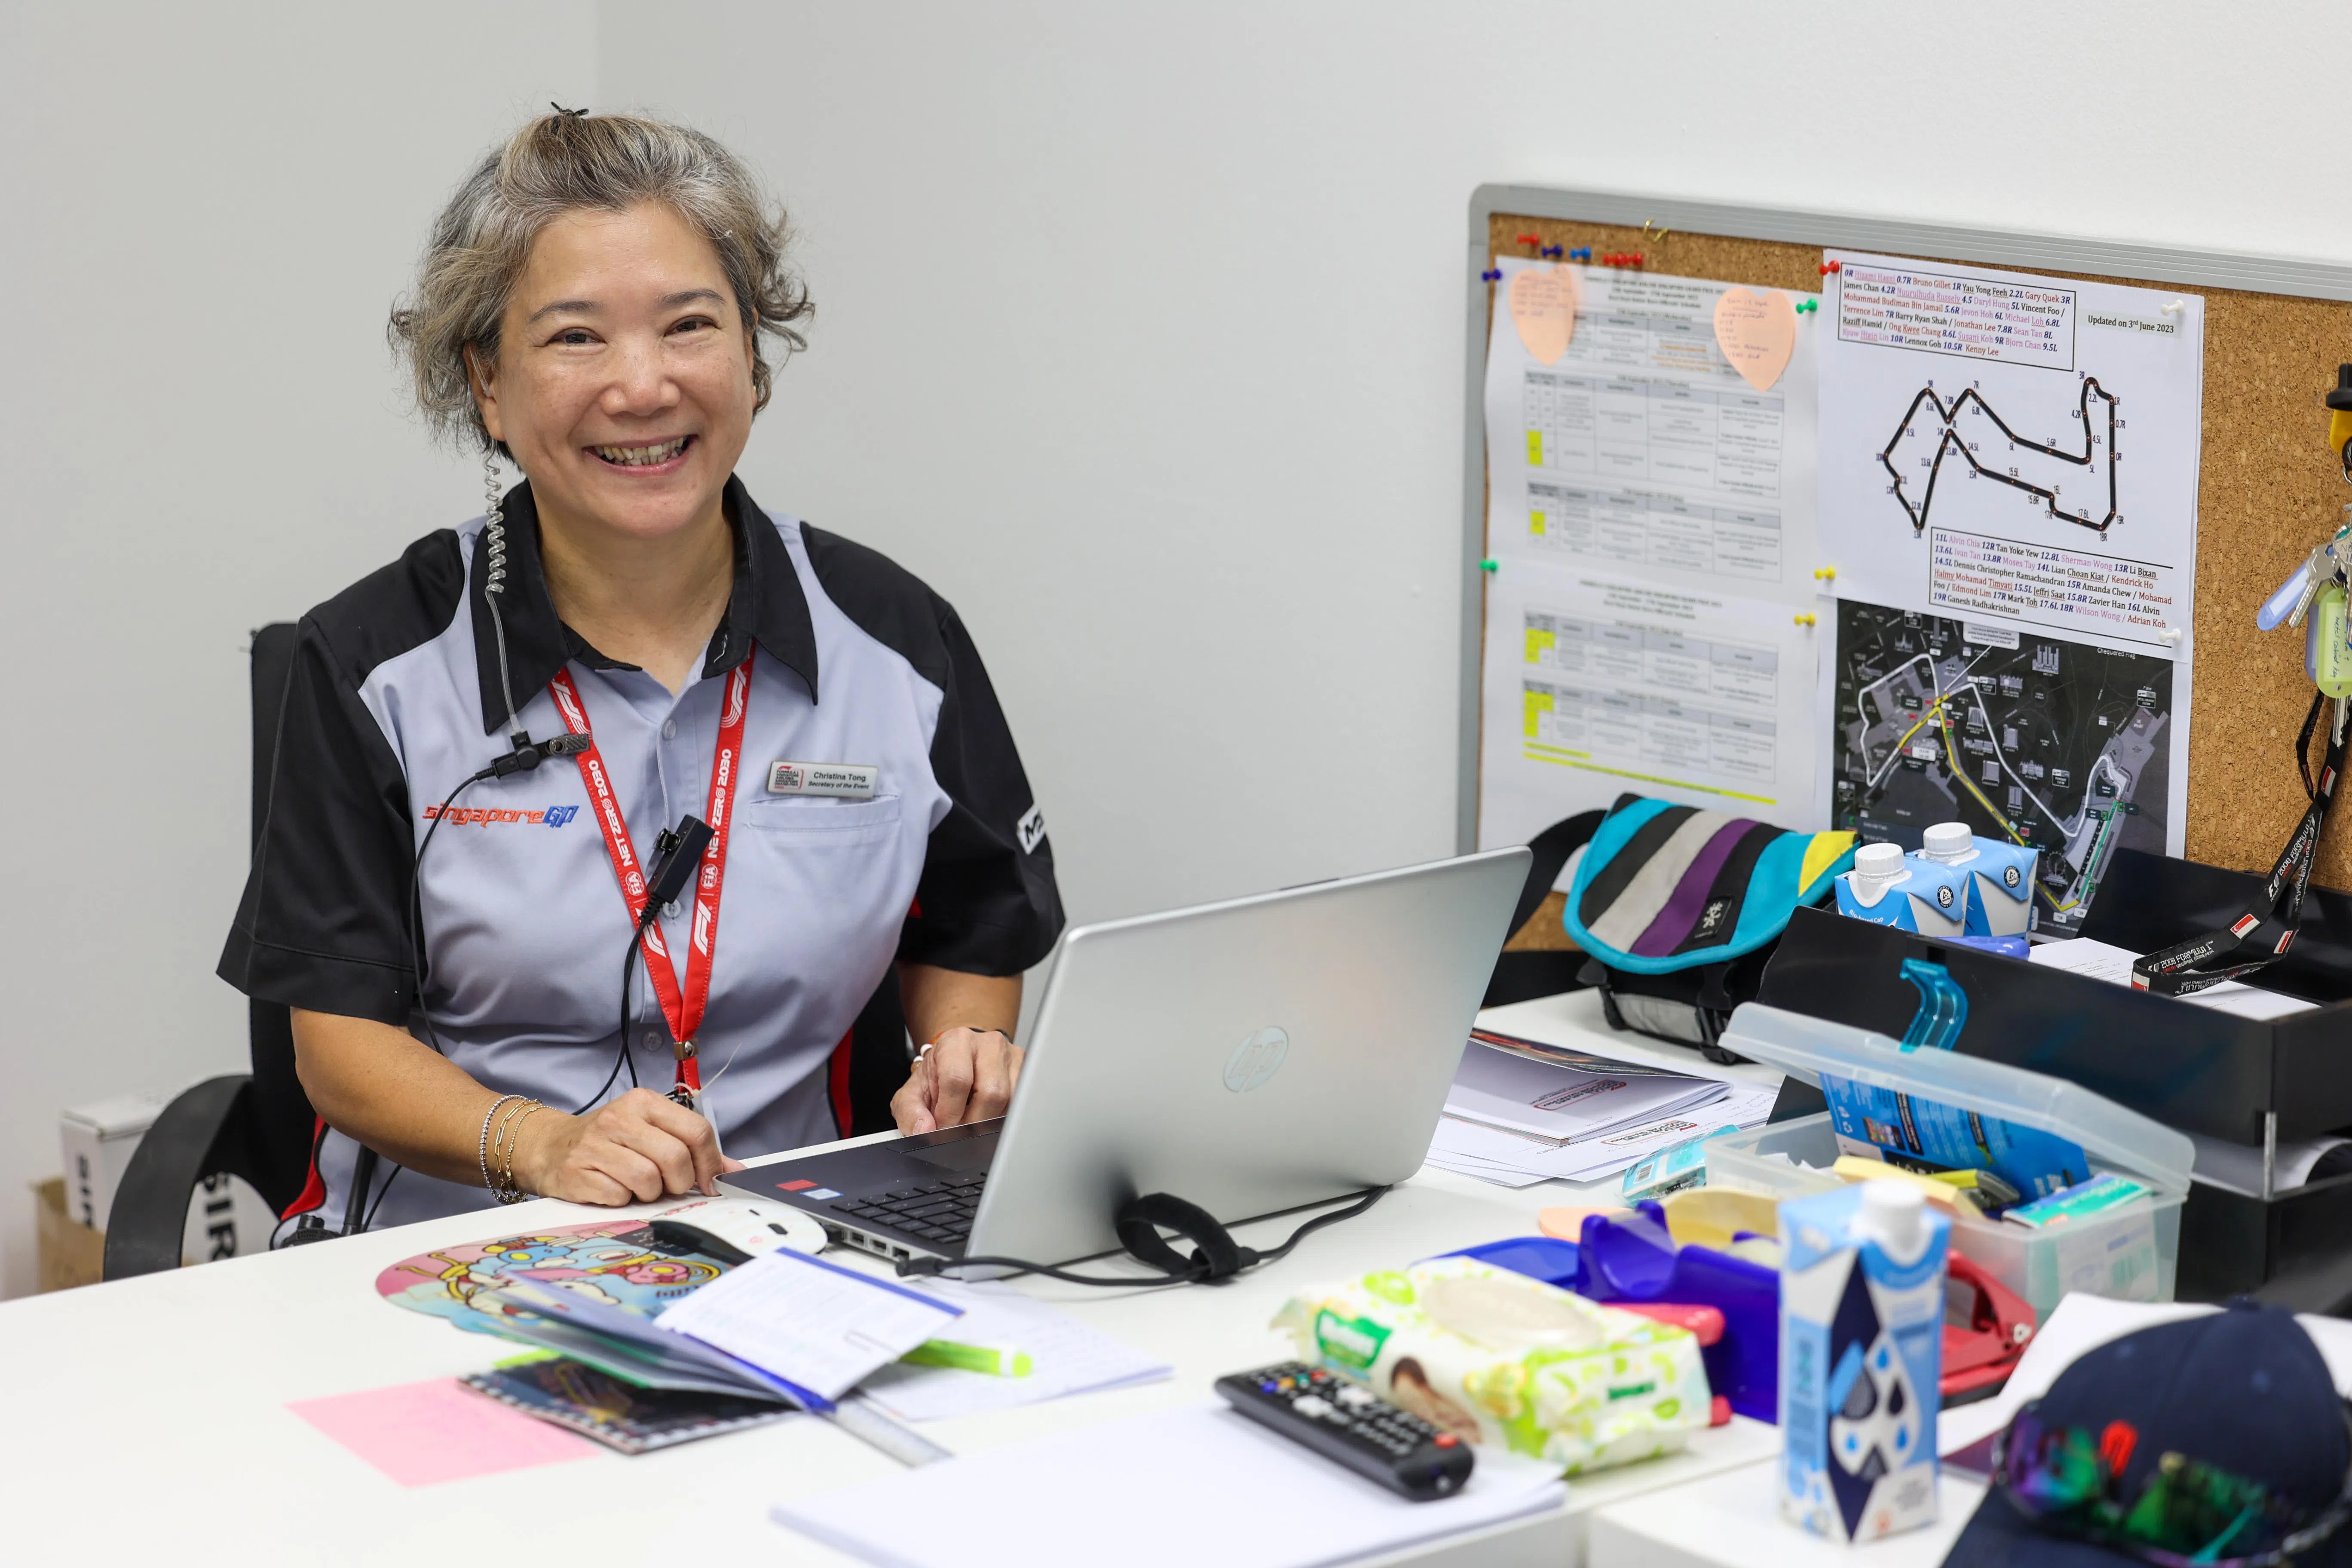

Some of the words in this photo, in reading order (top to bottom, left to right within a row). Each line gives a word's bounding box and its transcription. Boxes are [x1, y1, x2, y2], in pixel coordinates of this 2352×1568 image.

[1844, 281, 1862, 290] James
[1864, 283, 1879, 292] Chan
[1880, 285, 1895, 294] 4.2R
[1993, 300, 2009, 310] Hung
[2011, 302, 2020, 310] 5L
[2021, 304, 2046, 313] Vincent
[2047, 306, 2059, 315] Foo
[1896, 276, 1911, 284] 0.7R
[1913, 278, 1932, 287] Bruno
[1934, 280, 1951, 289] Gillet
[1963, 284, 1974, 293] Yau
[1975, 285, 1991, 296] Yong
[2009, 290, 2024, 298] 2.2L
[2025, 291, 2040, 303] Gary
[2043, 293, 2059, 303] Quek
[2061, 296, 2070, 304] 3R
[1844, 292, 1880, 303] Mohammad
[1882, 297, 1909, 307] Budiman
[1911, 301, 1921, 309] Bin
[1945, 306, 1960, 314] 5.6R
[1994, 312, 2003, 320] 6L
[2005, 313, 2030, 323] Michael
[2046, 318, 2060, 328] 6.8L
[1844, 305, 1870, 315] Terrence
[1872, 308, 1883, 317] Lim
[1896, 312, 1913, 322] Barry
[1915, 314, 1930, 324] Ryan
[1931, 316, 1947, 325] Shah
[1954, 319, 1982, 330] Jonathan
[1984, 323, 1995, 332] Lee
[1997, 325, 2012, 334] 7.8R
[2013, 327, 2029, 336] Sean
[2030, 330, 2042, 338] Tan
[2044, 331, 2052, 339] 8L
[2088, 315, 2116, 326] Updated
[2128, 320, 2138, 328] 3rd
[2139, 322, 2155, 331] June
[2156, 324, 2174, 333] 2023
[1862, 319, 1882, 328] Hamid
[1889, 323, 1901, 333] Ong
[1903, 325, 1920, 334] Kwee
[1921, 327, 1941, 337] Chang
[1942, 330, 1956, 338] 8.6L
[1980, 335, 1993, 343] Koh
[1995, 337, 2003, 345] 9R
[2025, 340, 2041, 350] Chan
[2043, 343, 2057, 352] 9.5L
[1891, 334, 1903, 343] 10R
[1905, 337, 1927, 346] Lennox
[1929, 340, 1941, 348] Goh
[1943, 341, 1962, 351] 10.5R
[1965, 344, 1985, 355] Kenny
[1988, 347, 1998, 355] Lee
[2079, 371, 2085, 380] 3R
[2089, 393, 2098, 403] 2.2L
[2071, 410, 2081, 419] 4.2R
[2115, 419, 2125, 429] 0.7R
[2046, 438, 2056, 447] 5.6R
[2092, 435, 2101, 444] 4.5L
[1935, 533, 1948, 542] 11L
[1981, 541, 1994, 551] 12R
[1996, 543, 2007, 553] Tan
[2009, 545, 2024, 556] Yoke
[2025, 548, 2039, 558] Yew
[2040, 551, 2060, 561] 12.8L
[2061, 554, 2091, 567] Sherman
[2093, 560, 2112, 572] Wong
[2114, 563, 2128, 573] 13R
[2130, 566, 2136, 574] Li
[1935, 545, 1953, 555] 13.6L
[1982, 553, 2001, 564] 13.8R
[2003, 557, 2022, 567] Moses
[2024, 560, 2035, 571] Tay
[2037, 563, 2050, 572] 14L
[2051, 565, 2065, 575] Lian
[2090, 572, 2104, 581] Kiat
[2111, 575, 2142, 588] Kendrick
[2144, 580, 2153, 589] Ho
[1935, 557, 1952, 567] 14.5L
[1954, 560, 1975, 570] Dennis
[1977, 564, 2015, 578] Christopher
[2016, 572, 2065, 586] Ramachandran
[2067, 580, 2081, 589] 15R
[2082, 582, 2110, 594] Amanda
[2112, 588, 2131, 597] Chew
[2138, 591, 2171, 605] Mohamad
[1956, 573, 1987, 585] Mohamad
[2014, 583, 2032, 594] 15.5L
[2067, 593, 2087, 603] 15.8R
[2089, 596, 2110, 606] Zavier
[2112, 600, 2125, 609] Han
[2127, 603, 2141, 612] 16L
[2142, 605, 2160, 616] Alvin
[1933, 592, 1946, 601] 19R
[1948, 595, 1970, 606] Ganesh
[1972, 598, 2019, 615] Radhakrishnan
[1934, 580, 1945, 589] Foo
[1952, 584, 1978, 595] Edmond
[1979, 588, 1991, 598] Lim
[1993, 591, 2006, 600] 17R
[2007, 594, 2024, 604] Mark
[2025, 597, 2038, 606] Toh
[2040, 600, 2058, 610] 17.6L
[2060, 603, 2073, 612] 18R
[2076, 605, 2099, 617] Wilson
[2101, 610, 2120, 623] Wong
[2127, 615, 2151, 626] Adrian
[2153, 619, 2166, 628] Koh
[588, 760, 609, 798] 2030
[717, 749, 732, 787] 2030
[814, 772, 846, 781] Christina
[849, 774, 866, 783] Tong
[808, 781, 835, 790] Secretary
[614, 833, 633, 867] NET
[2160, 957, 2176, 969] 2008
[2175, 946, 2207, 964] FORMULA
